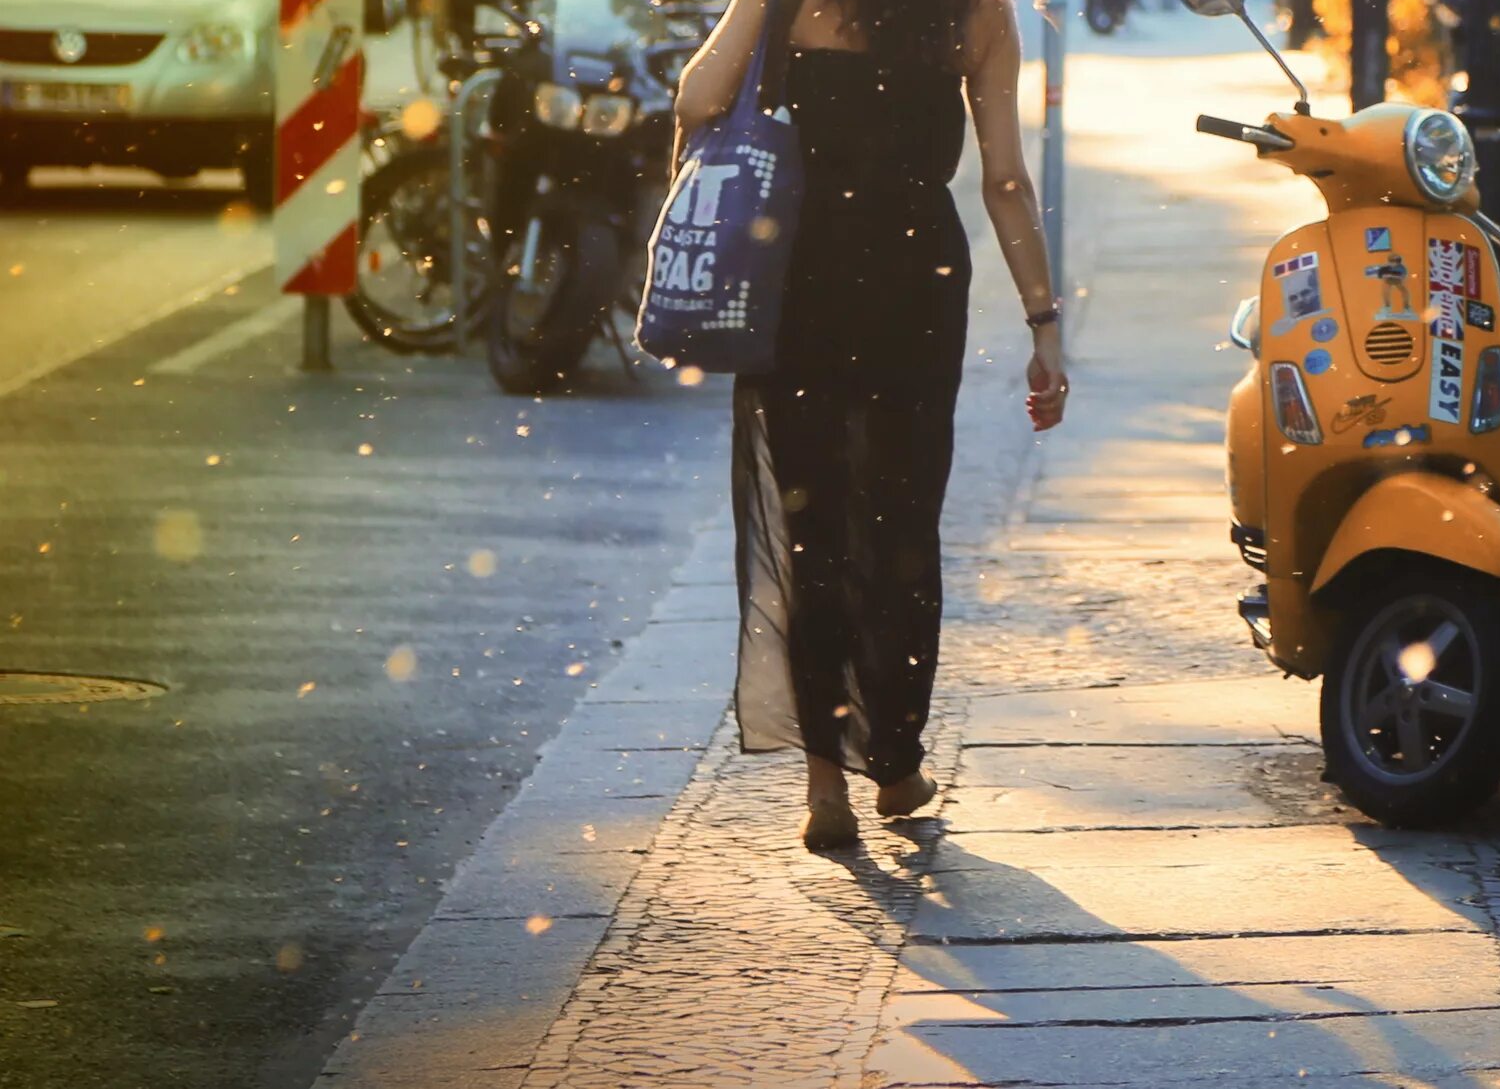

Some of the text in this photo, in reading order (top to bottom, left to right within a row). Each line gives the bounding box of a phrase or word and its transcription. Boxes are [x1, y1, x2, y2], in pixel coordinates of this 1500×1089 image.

[704, 231, 716, 247] A
[652, 244, 716, 292] BAG
[1438, 342, 1462, 420] EASY
